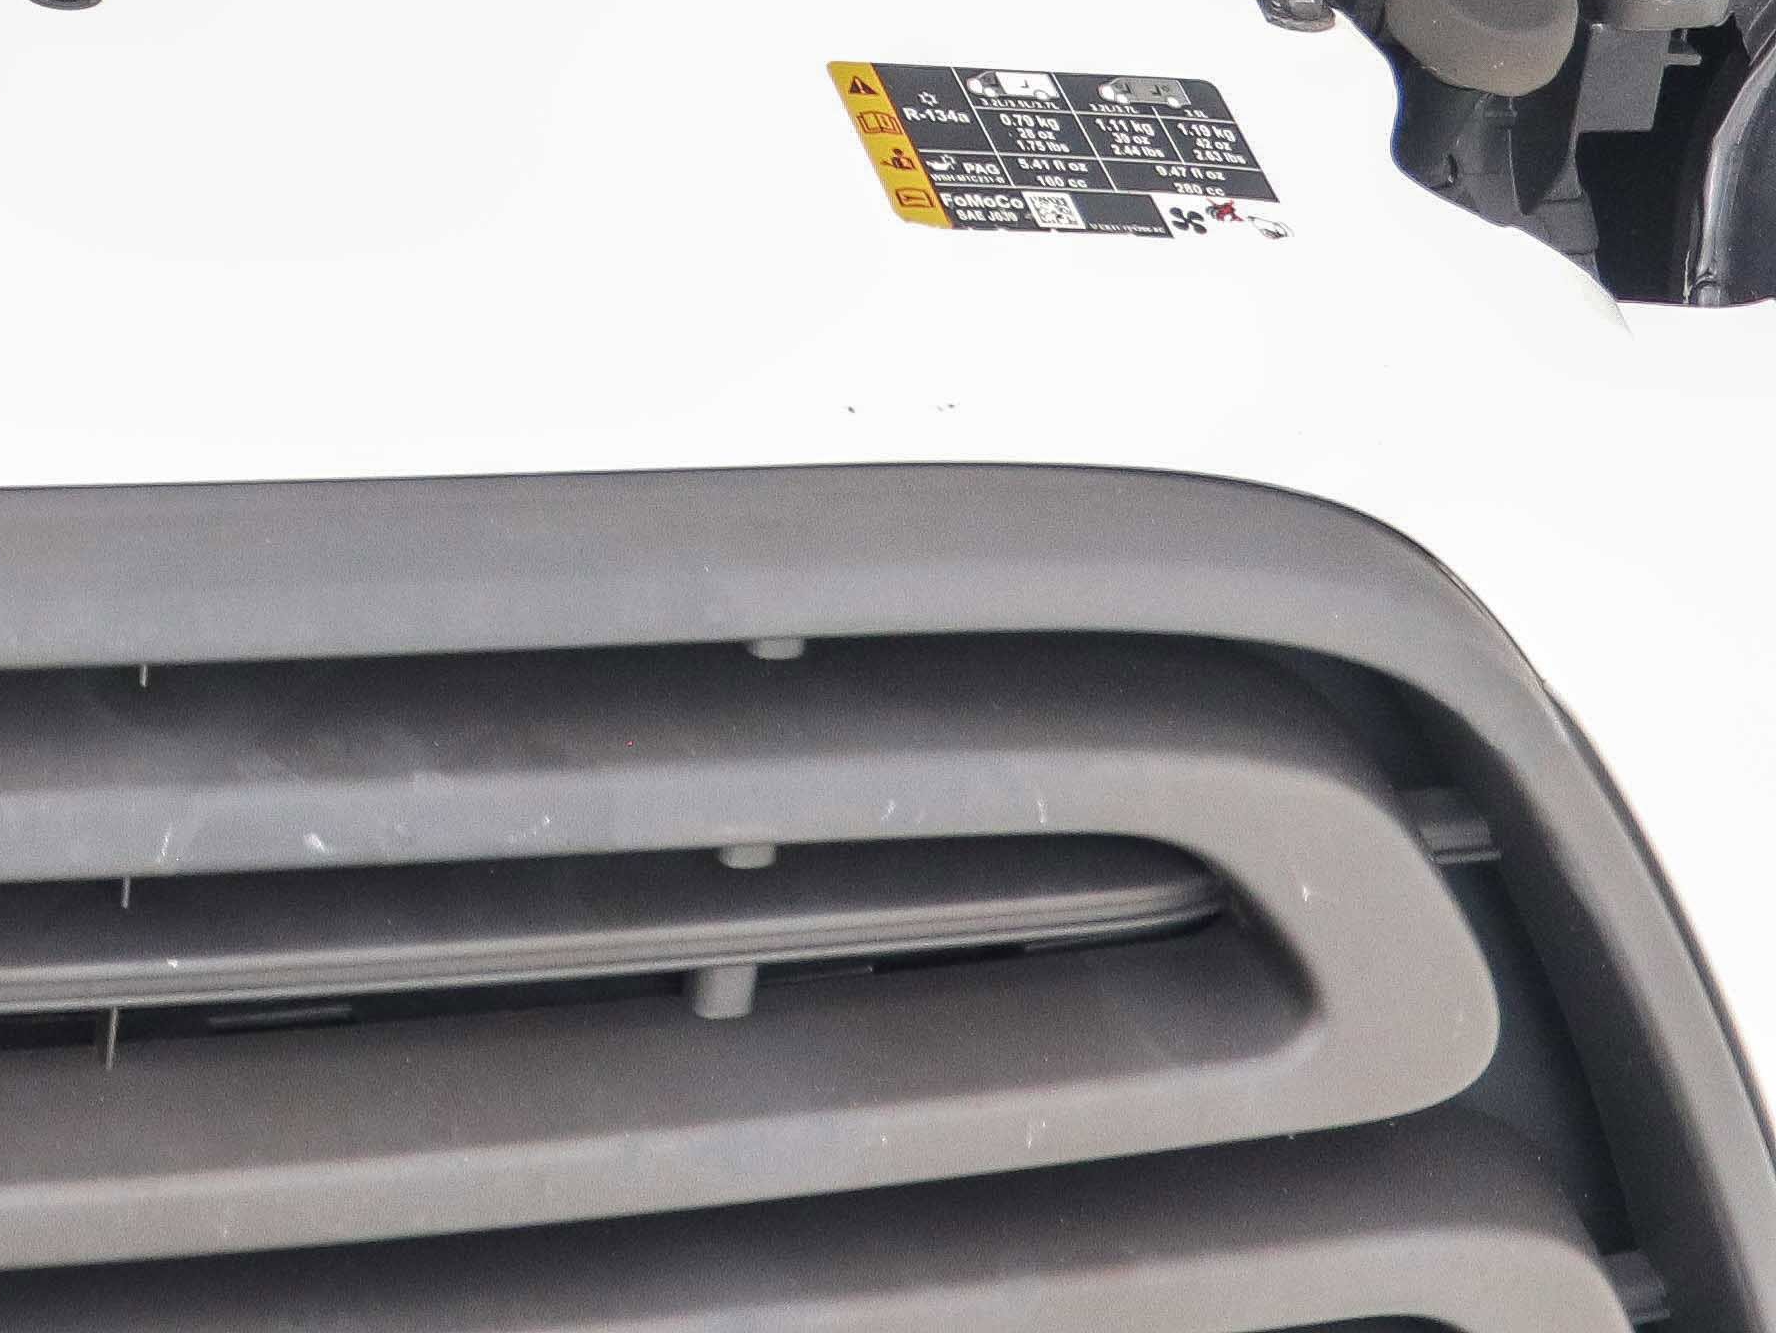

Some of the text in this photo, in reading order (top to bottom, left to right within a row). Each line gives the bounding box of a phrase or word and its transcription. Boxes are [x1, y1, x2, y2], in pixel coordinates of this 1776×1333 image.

[902, 107, 970, 123] R-134a
[1036, 115, 1060, 132] kg
[1095, 118, 1155, 137] 1.11 kg
[1017, 128, 1056, 140] 28 oz
[1177, 122, 1236, 142] 1.19 kg
[1016, 139, 1070, 152] 1.75 lbs
[1133, 135, 1151, 145] oz
[1196, 138, 1233, 151] 42 oz
[1111, 144, 1165, 158] 2.44 lbs
[1017, 158, 1089, 172] 5.41 fl oz
[1225, 152, 1247, 165] lbs
[961, 162, 1000, 175] PAG
[1190, 166, 1204, 179] fl
[1206, 171, 1226, 181] oz
[1068, 179, 1088, 188] cc
[1173, 182, 1225, 196] 280 cc
[939, 192, 1025, 209] FoMoCo
[955, 209, 986, 221] SAE
